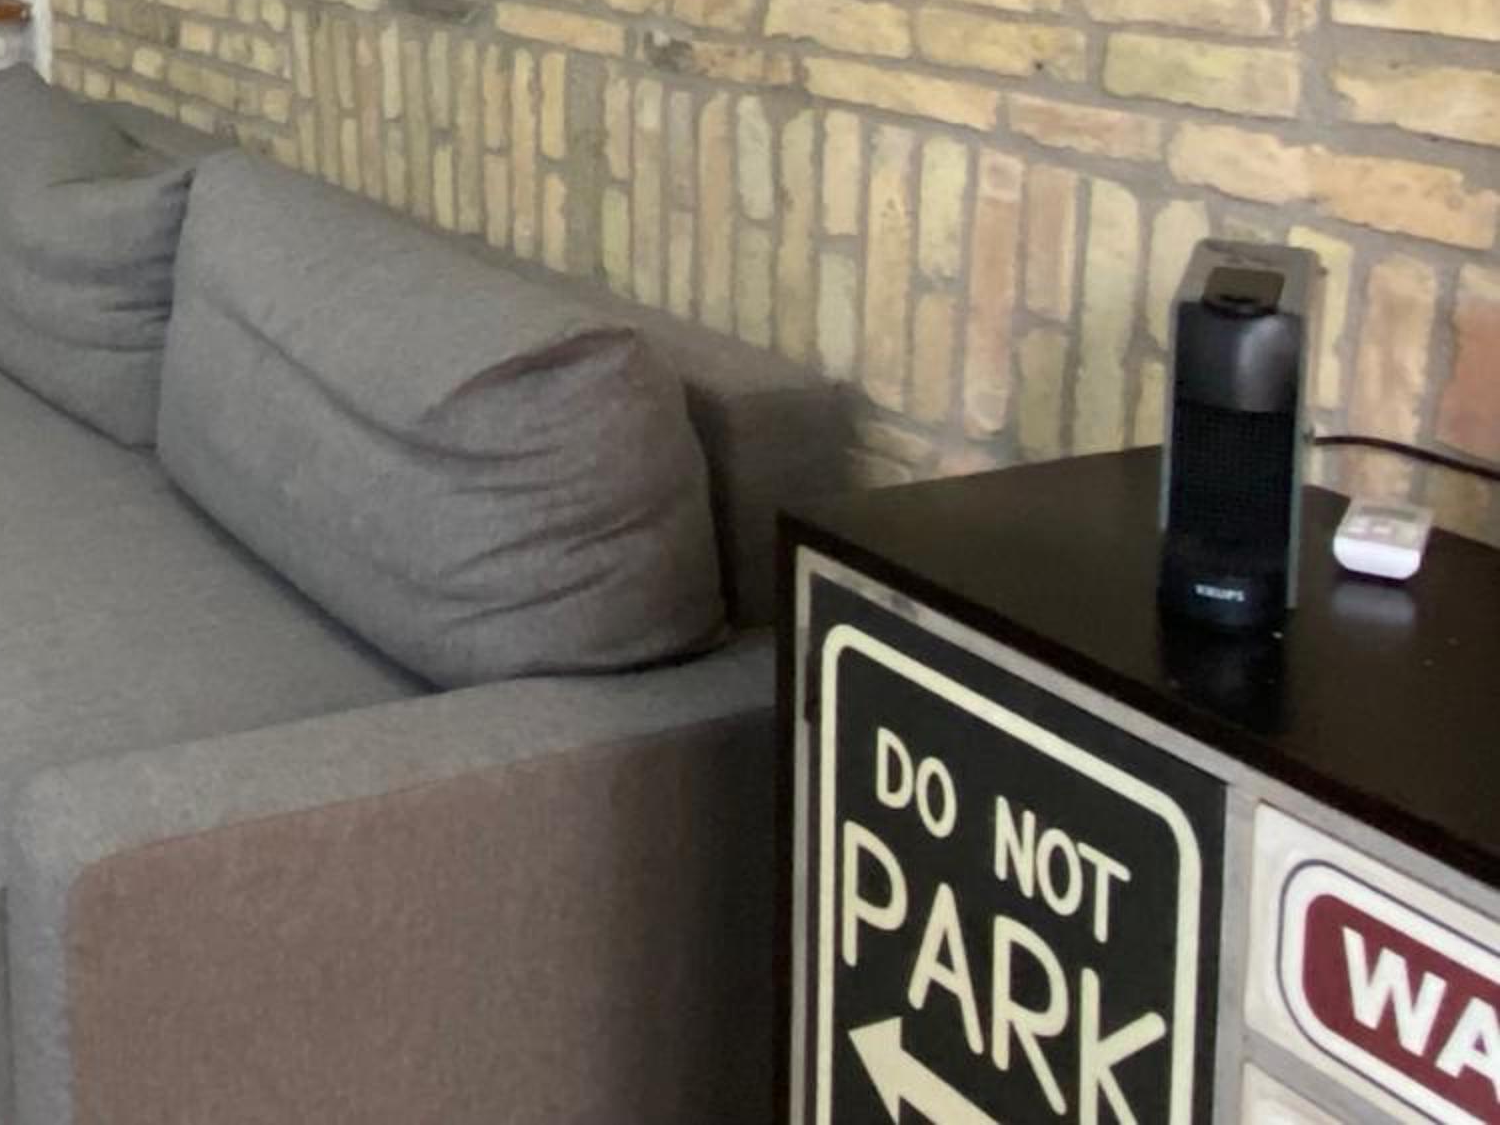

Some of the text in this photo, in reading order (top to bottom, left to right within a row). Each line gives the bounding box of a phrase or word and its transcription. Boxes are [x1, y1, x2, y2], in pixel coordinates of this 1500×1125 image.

[876, 726, 1131, 943] DO NOT
[842, 820, 1167, 1125] PARK
[1342, 924, 1500, 1104] WA
